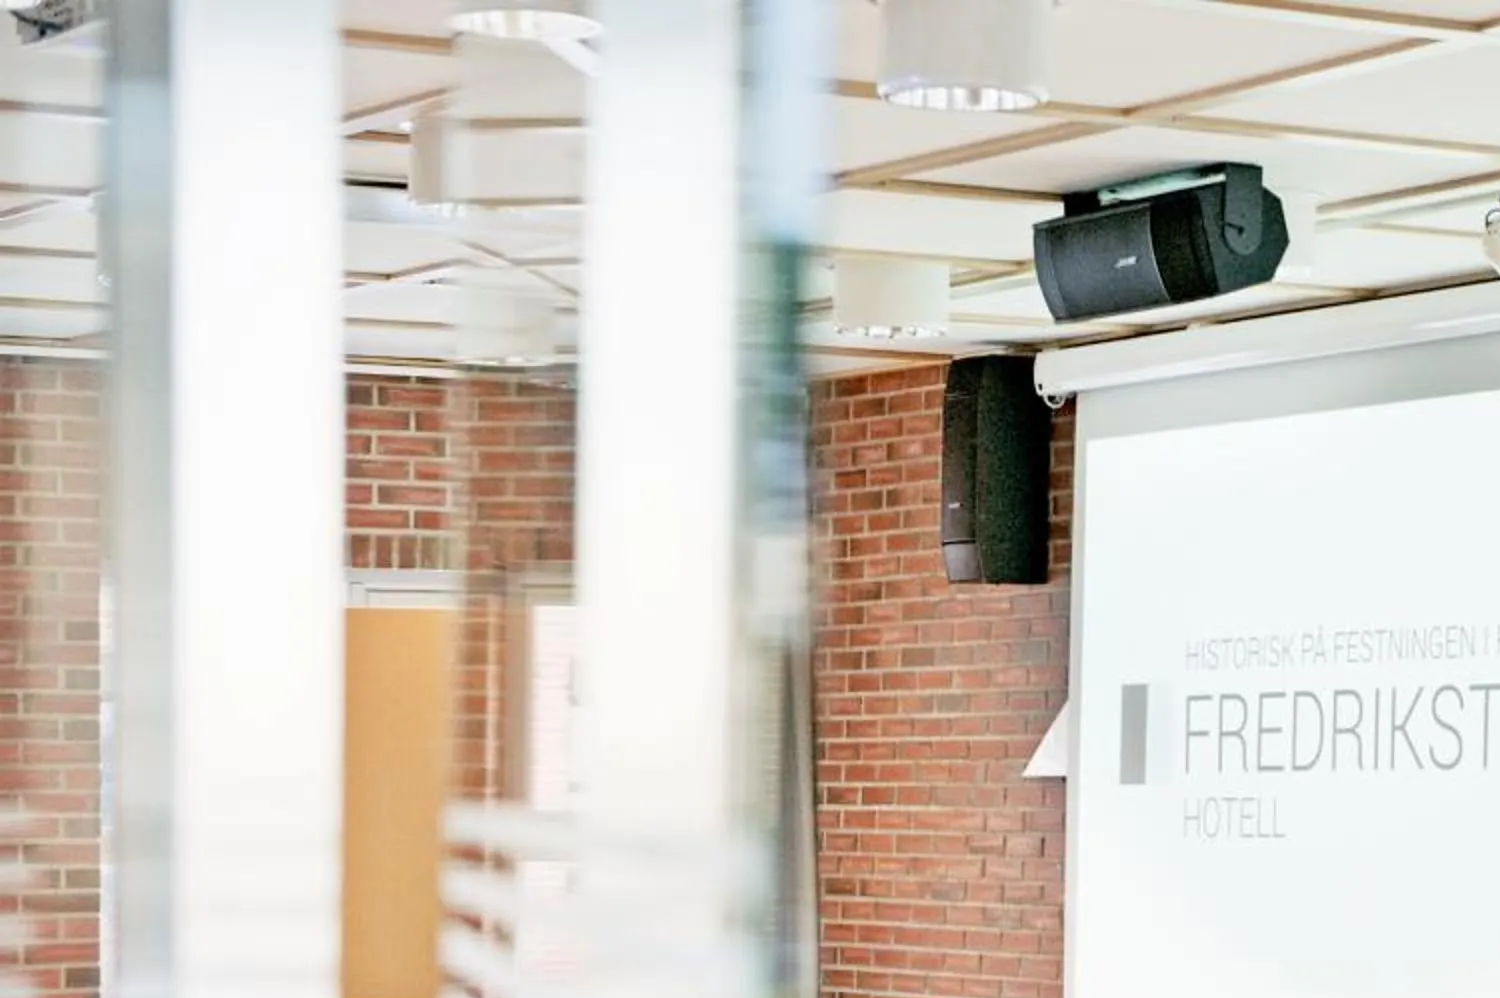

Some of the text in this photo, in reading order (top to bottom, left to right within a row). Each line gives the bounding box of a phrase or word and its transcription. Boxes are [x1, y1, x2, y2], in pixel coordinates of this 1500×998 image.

[1185, 636, 1296, 672] HISTORISK
[1300, 624, 1328, 667] PÅ
[1333, 624, 1476, 664] FESTNINGEN
[1183, 796, 1286, 839] HOTELL
